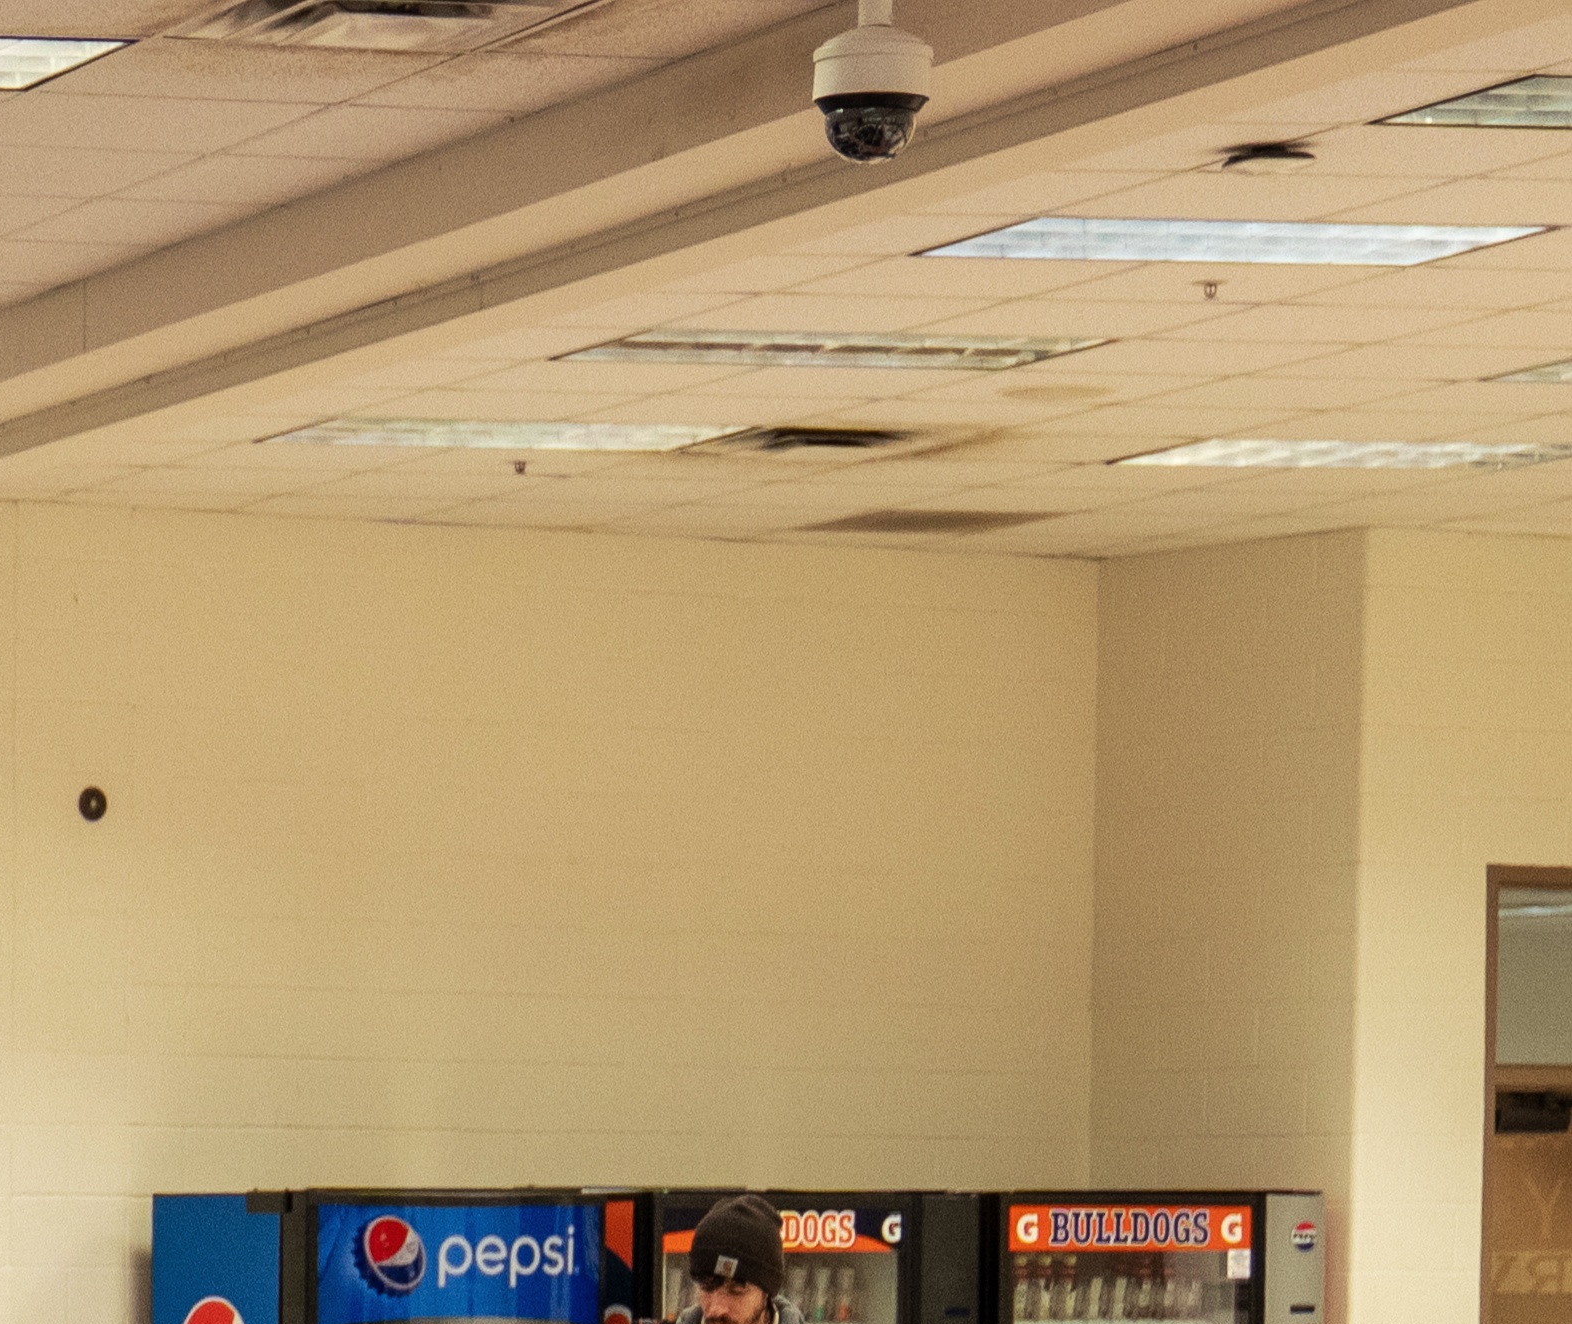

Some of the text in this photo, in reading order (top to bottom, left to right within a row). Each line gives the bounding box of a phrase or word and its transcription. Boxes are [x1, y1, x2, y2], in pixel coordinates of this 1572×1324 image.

[780, 1210, 856, 1248] DOGS
[1050, 1208, 1210, 1247] BULLDOGS
[438, 1223, 575, 1289] pepsi
